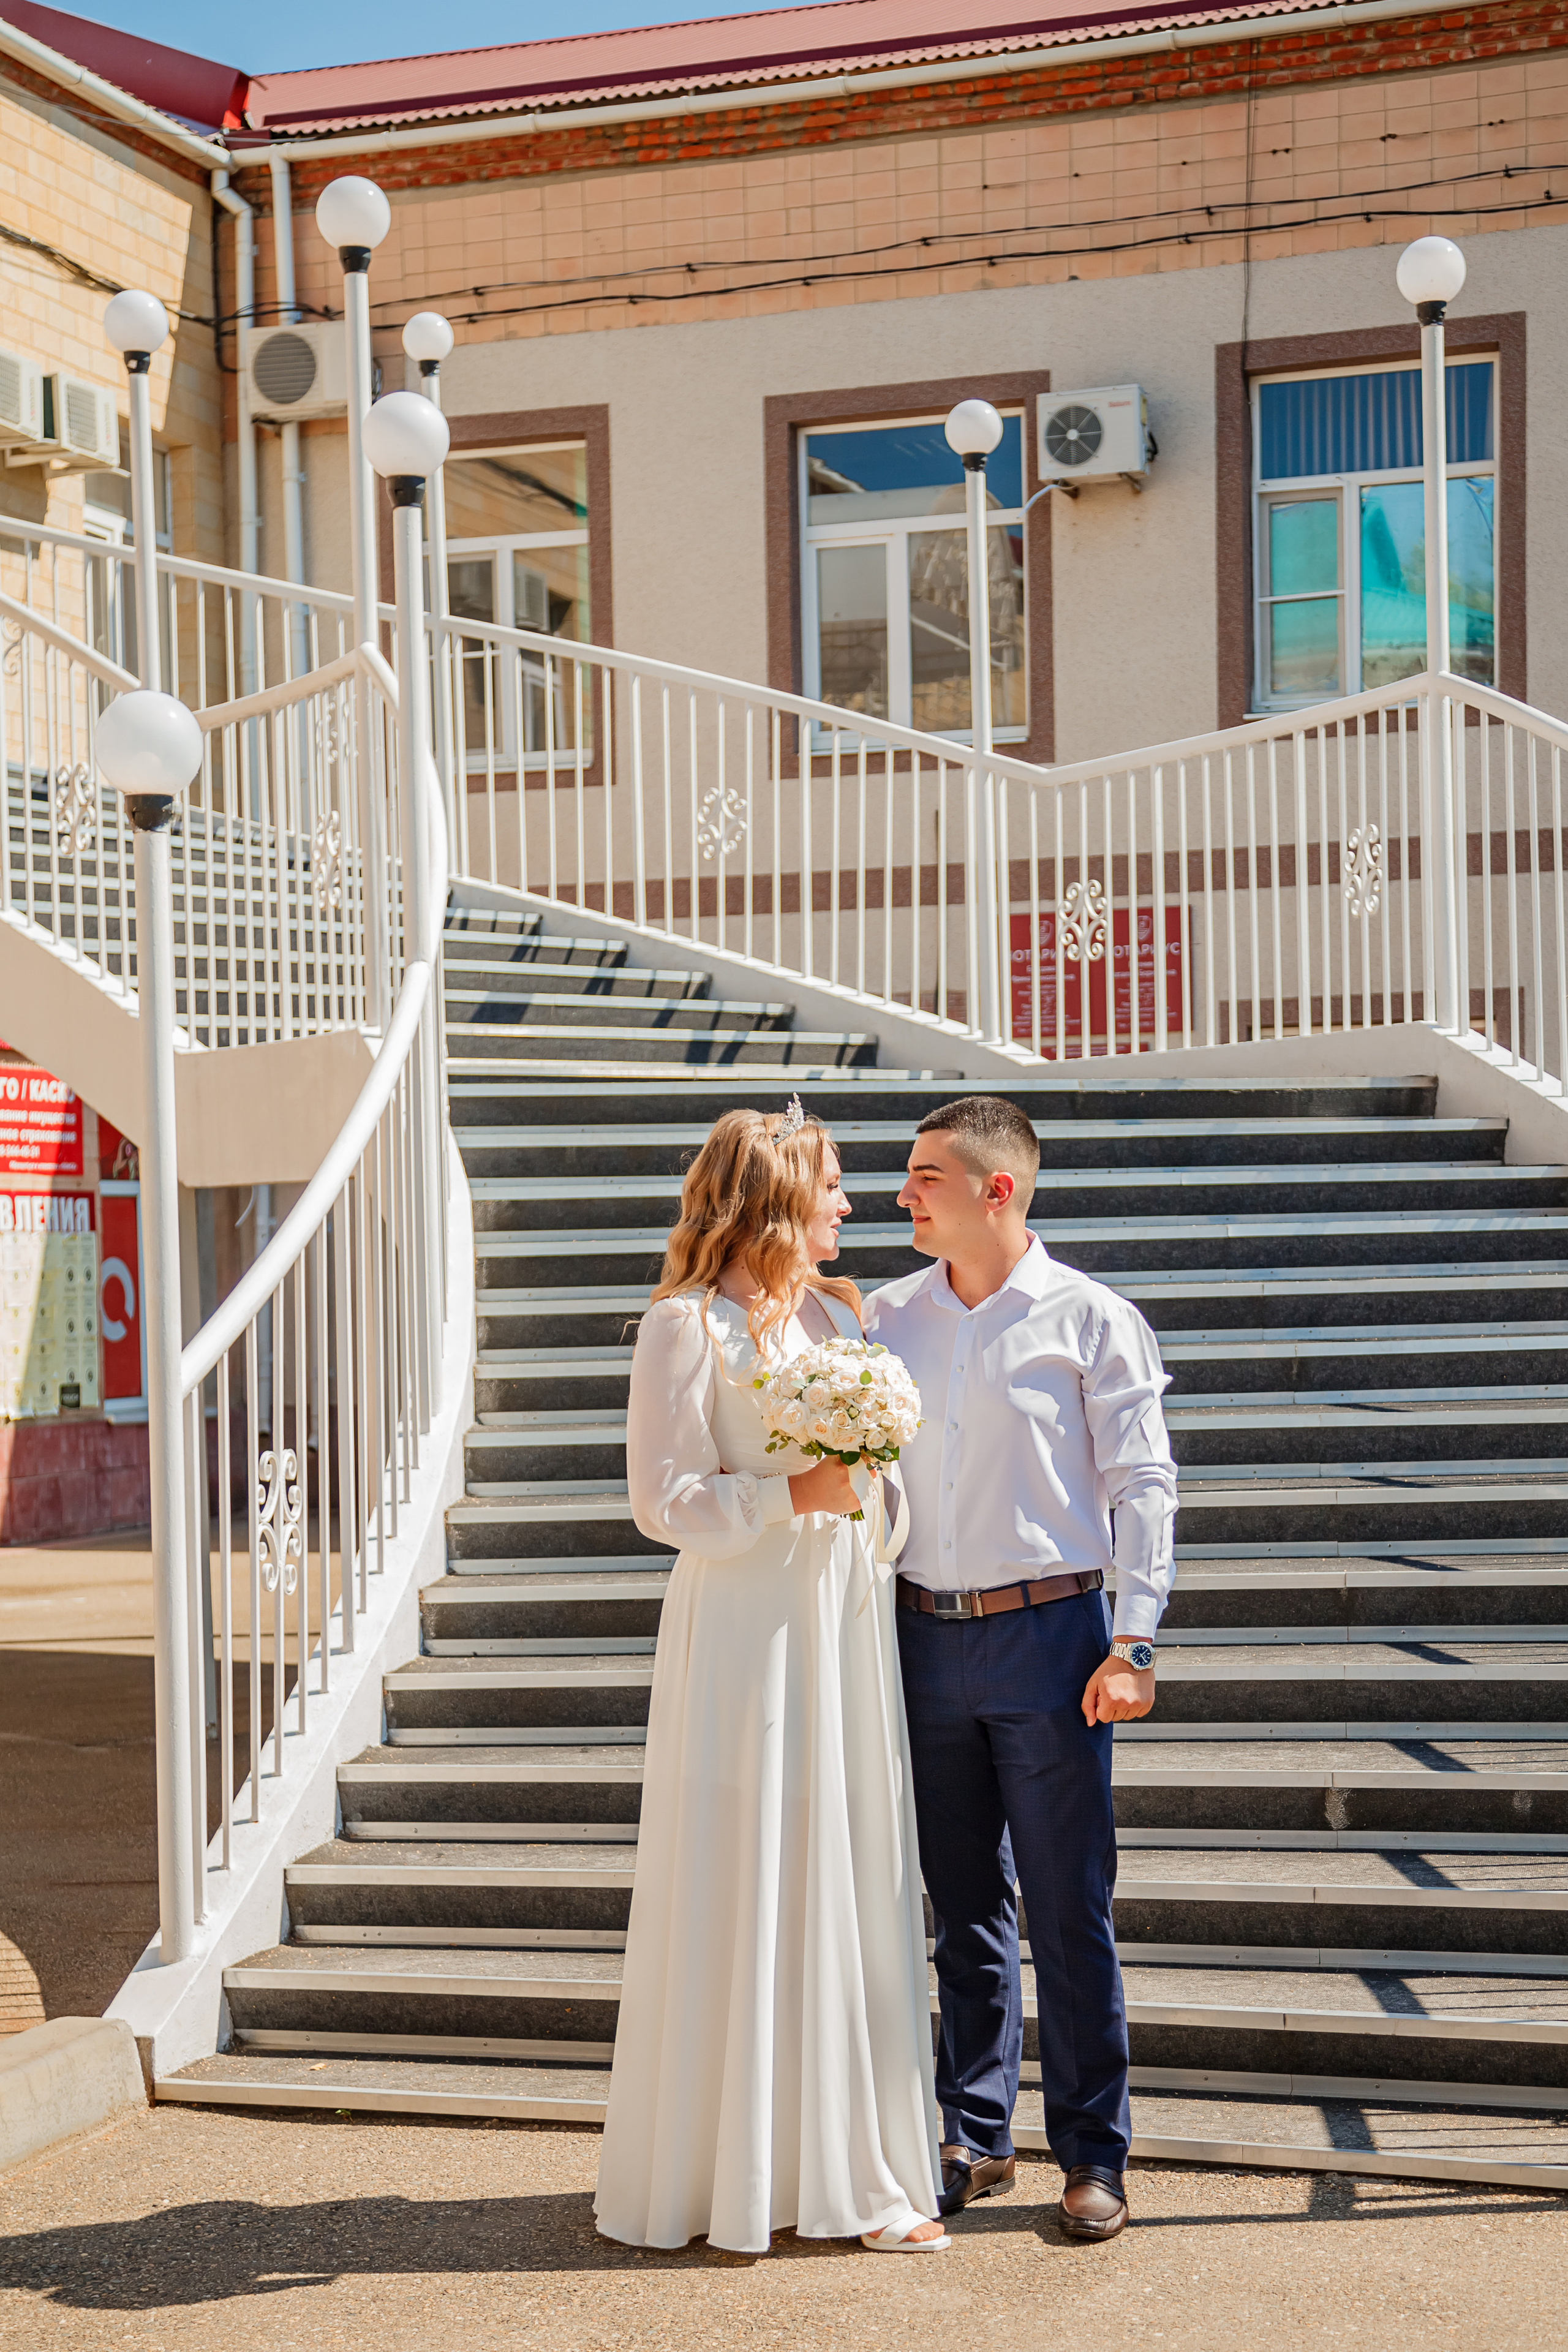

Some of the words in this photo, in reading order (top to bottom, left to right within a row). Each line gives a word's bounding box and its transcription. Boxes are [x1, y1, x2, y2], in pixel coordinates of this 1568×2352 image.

[1009, 947, 1072, 962] ОТРИ
[1102, 942, 1181, 959] ОТРУС
[29, 1111, 76, 1126] имущества
[20, 1129, 76, 1144] страхование
[0, 1194, 90, 1232] ВЛЕНИЯ
